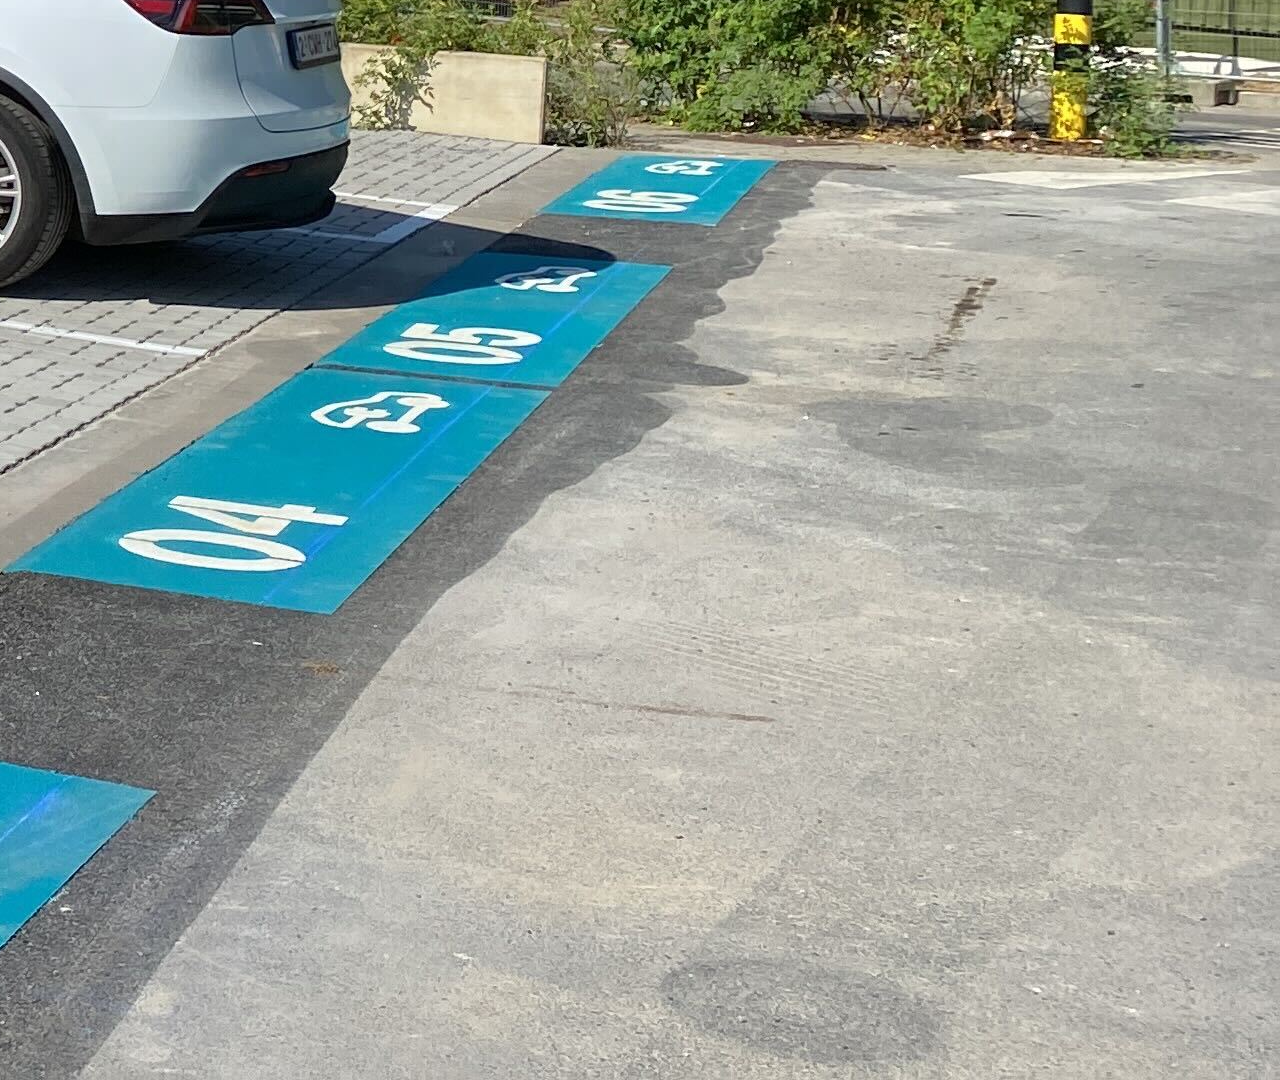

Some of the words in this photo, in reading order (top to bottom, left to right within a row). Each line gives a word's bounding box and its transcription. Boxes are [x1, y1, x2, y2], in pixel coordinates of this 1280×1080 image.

[582, 189, 699, 213] 06
[383, 323, 542, 365] 05
[118, 496, 349, 572] 04
